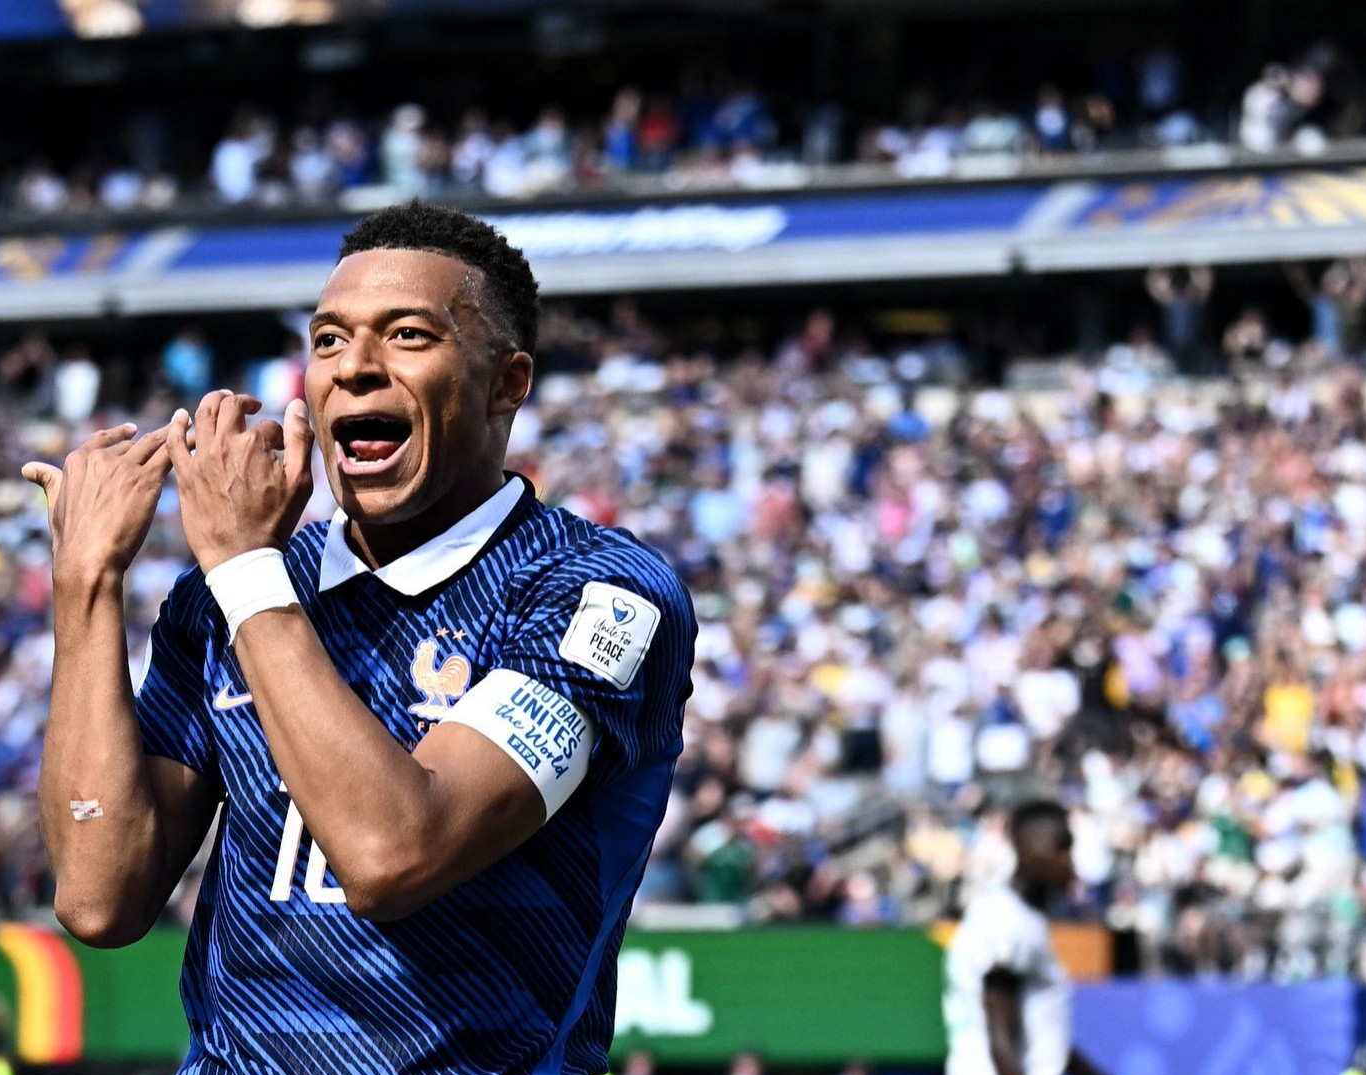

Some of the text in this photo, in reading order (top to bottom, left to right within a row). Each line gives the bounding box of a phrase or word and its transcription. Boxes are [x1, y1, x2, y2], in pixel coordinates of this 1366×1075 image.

[590, 633, 625, 663] PEACE
[593, 618, 632, 646] Unite For
[592, 651, 610, 667] FIFA
[510, 687, 577, 759] UNITES
[524, 679, 586, 742] FOOTBALL
[495, 703, 569, 779] the World
[509, 735, 540, 770] FIFA
